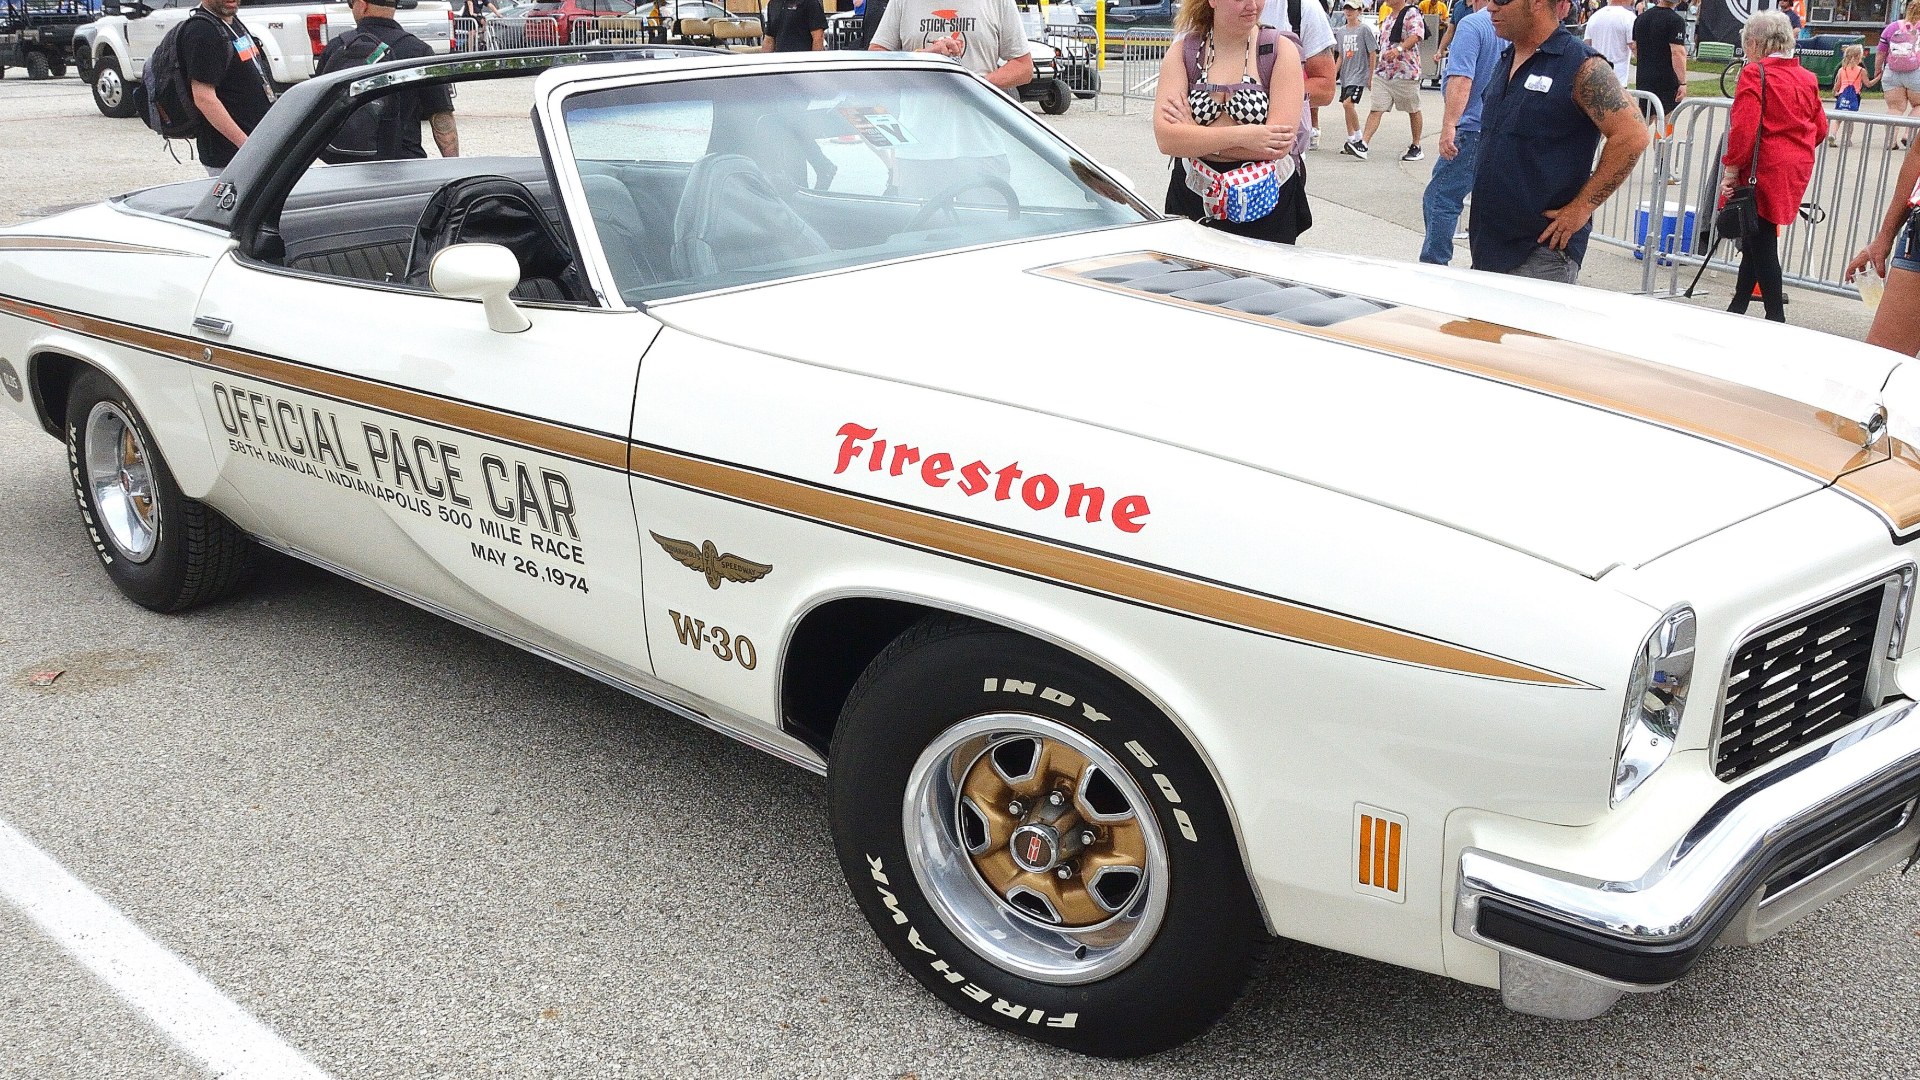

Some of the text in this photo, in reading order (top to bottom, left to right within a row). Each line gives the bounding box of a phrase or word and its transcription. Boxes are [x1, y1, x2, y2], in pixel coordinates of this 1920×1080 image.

[920, 18, 976, 32] STICK-SHIFT
[68, 422, 113, 565] FIREHAWK
[211, 381, 362, 475] OFFICIAL
[361, 420, 473, 510] PACE
[479, 452, 582, 541] CAR
[228, 438, 585, 565] 58TH ANNUAL INDIANAPOLIS 500 MILE RACE
[833, 422, 1151, 533] Firestone
[470, 541, 507, 567] MAY
[721, 561, 757, 576] SPEEDWAY
[668, 609, 757, 670] W-30
[983, 677, 1198, 843] INDY 500
[865, 852, 1079, 1029] FIREHAWK
